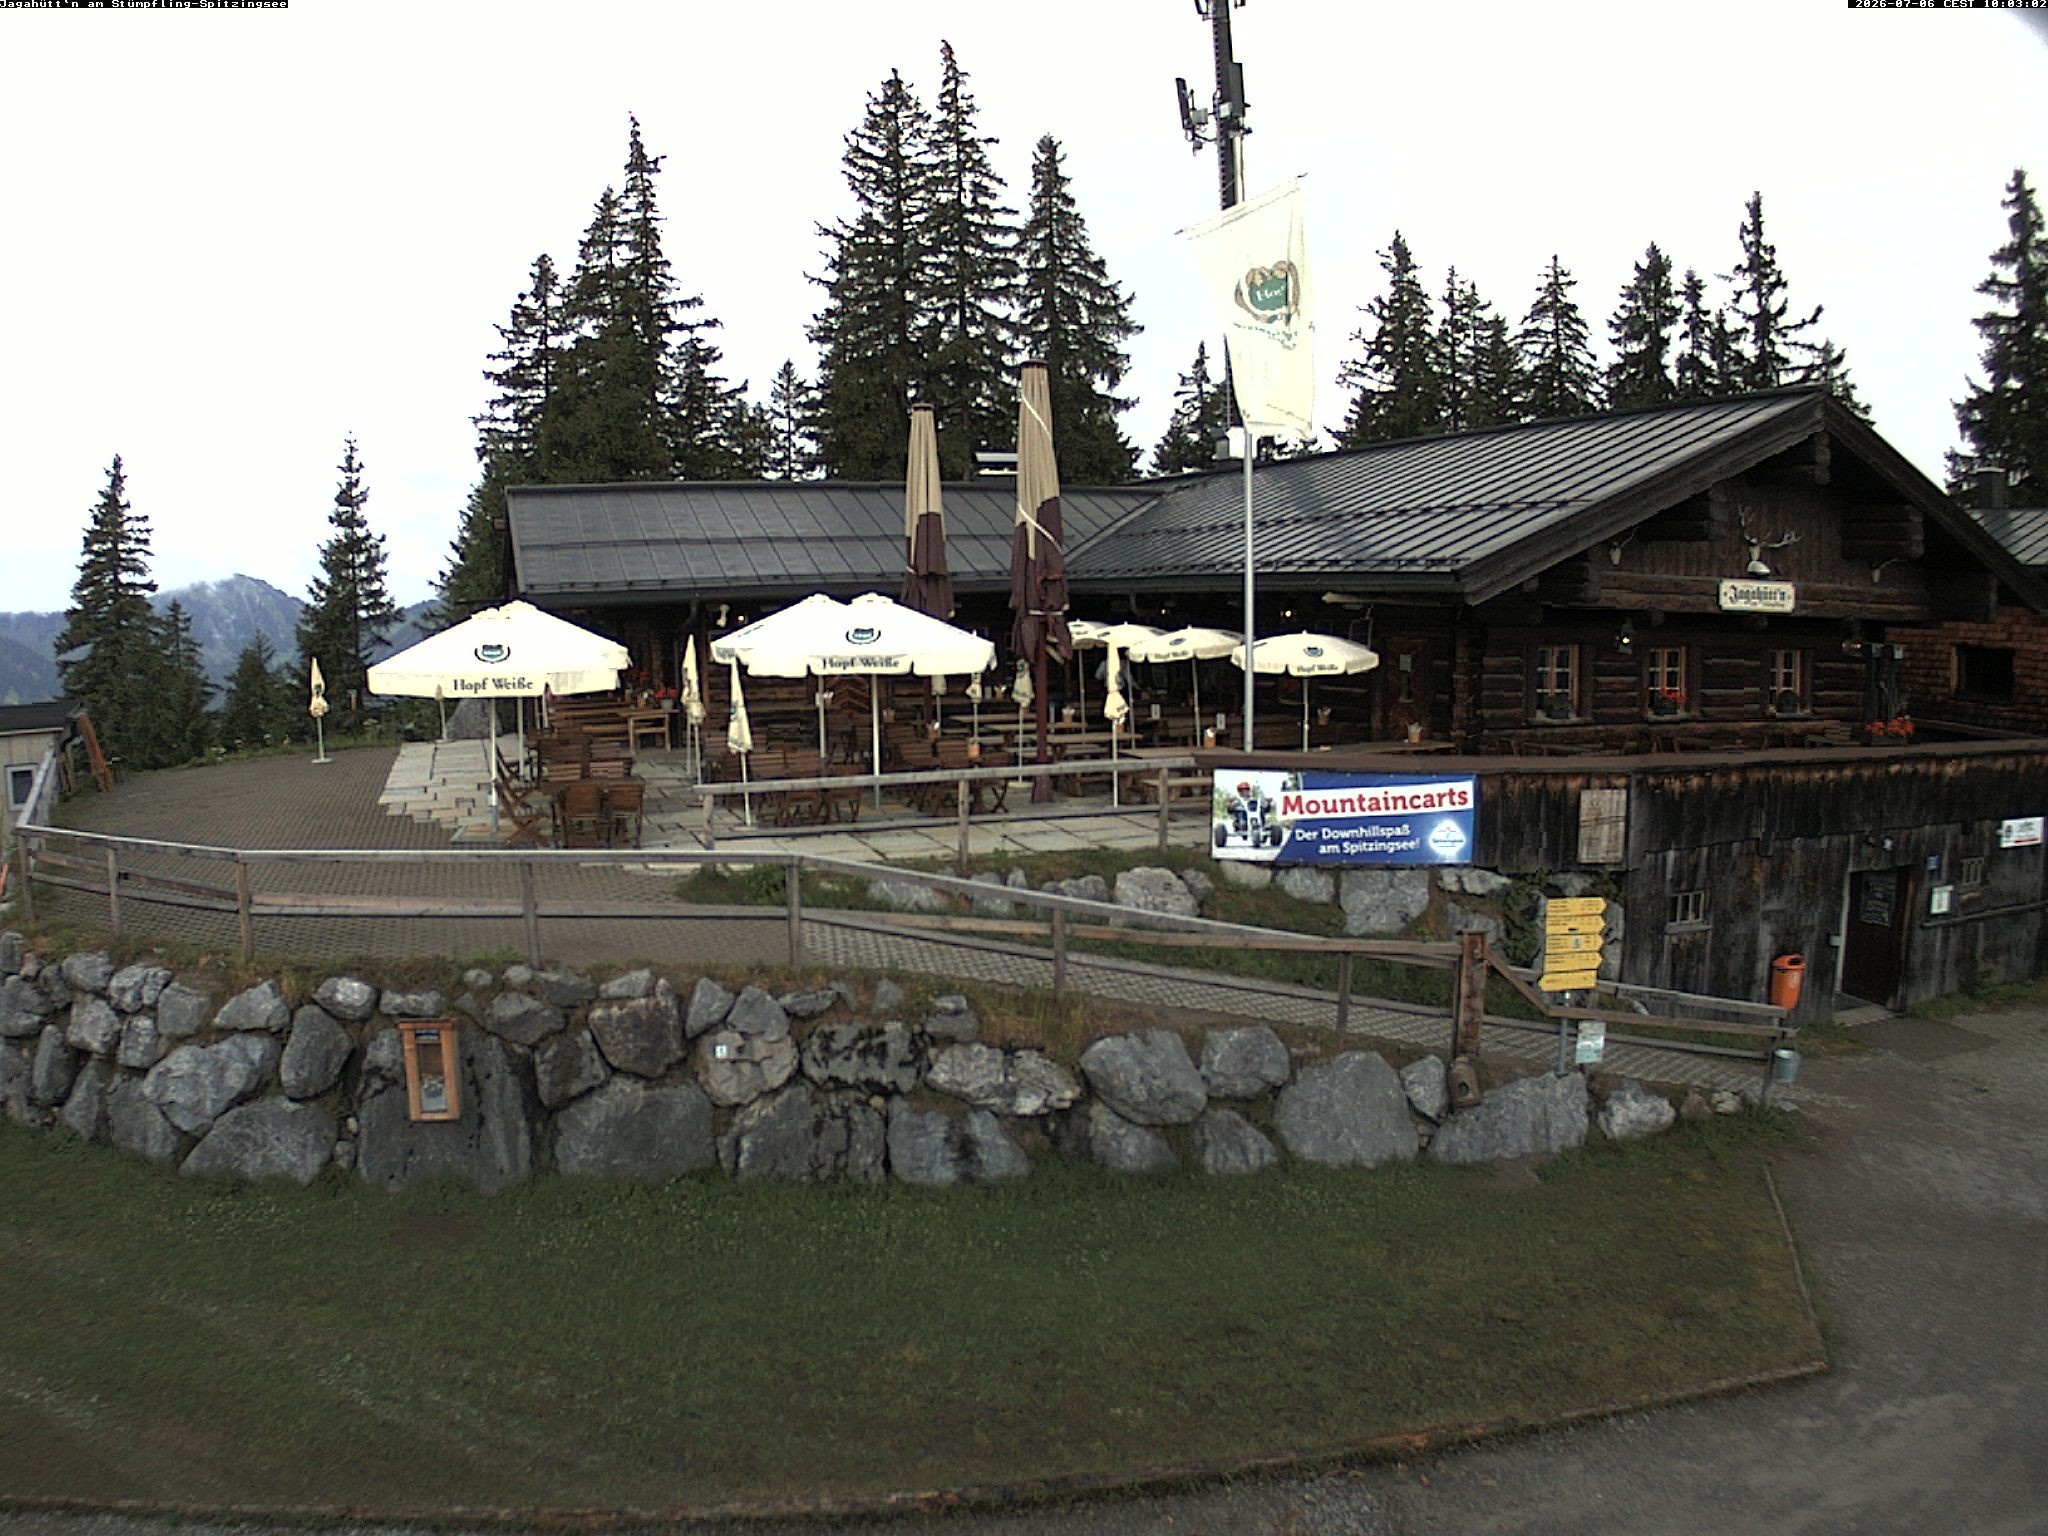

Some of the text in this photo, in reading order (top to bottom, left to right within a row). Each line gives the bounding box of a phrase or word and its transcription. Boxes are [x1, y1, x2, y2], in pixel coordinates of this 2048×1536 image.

[822, 656, 900, 671] Hopf Weiße
[453, 677, 534, 694] Hopf Weiße
[1281, 789, 1469, 816] Mountaincarts
[1295, 824, 1411, 842] Der Downhillspaß
[1319, 844, 1342, 855] am
[1343, 838, 1420, 857] Spitzingsee!
